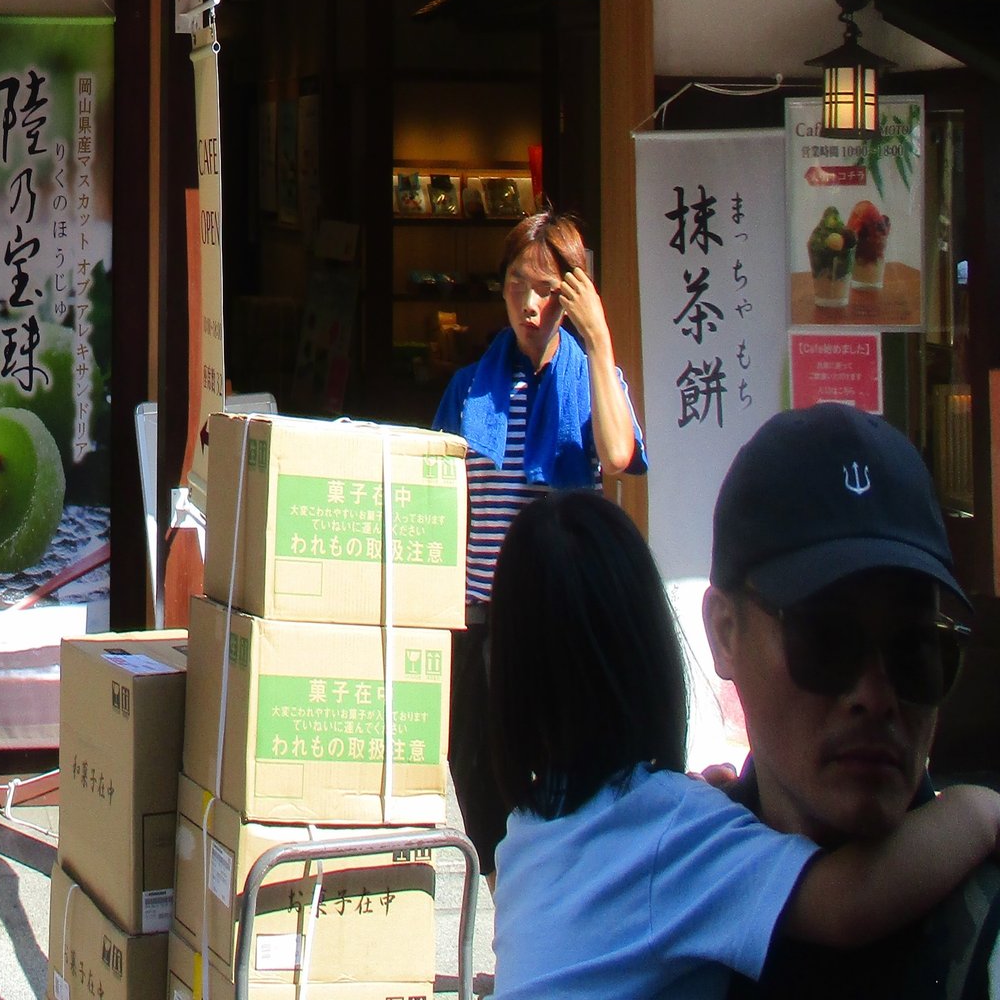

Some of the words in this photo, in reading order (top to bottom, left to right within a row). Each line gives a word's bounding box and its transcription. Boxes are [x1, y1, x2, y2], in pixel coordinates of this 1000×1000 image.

[795, 122, 822, 138] Caf
[198, 138, 218, 177] CAFE
[52, 142, 68, 315] りくのほうじゅ
[200, 209, 221, 248] OPEN
[664, 184, 728, 429] 抹茶餅
[289, 504, 446, 527] 大変こわれやすいお菓子入っております
[312, 518, 426, 537] ていねいに運んください
[271, 704, 429, 724] 大変こわれやすいお菓子が入ております
[293, 718, 408, 736] ていねいに運んでくさい
